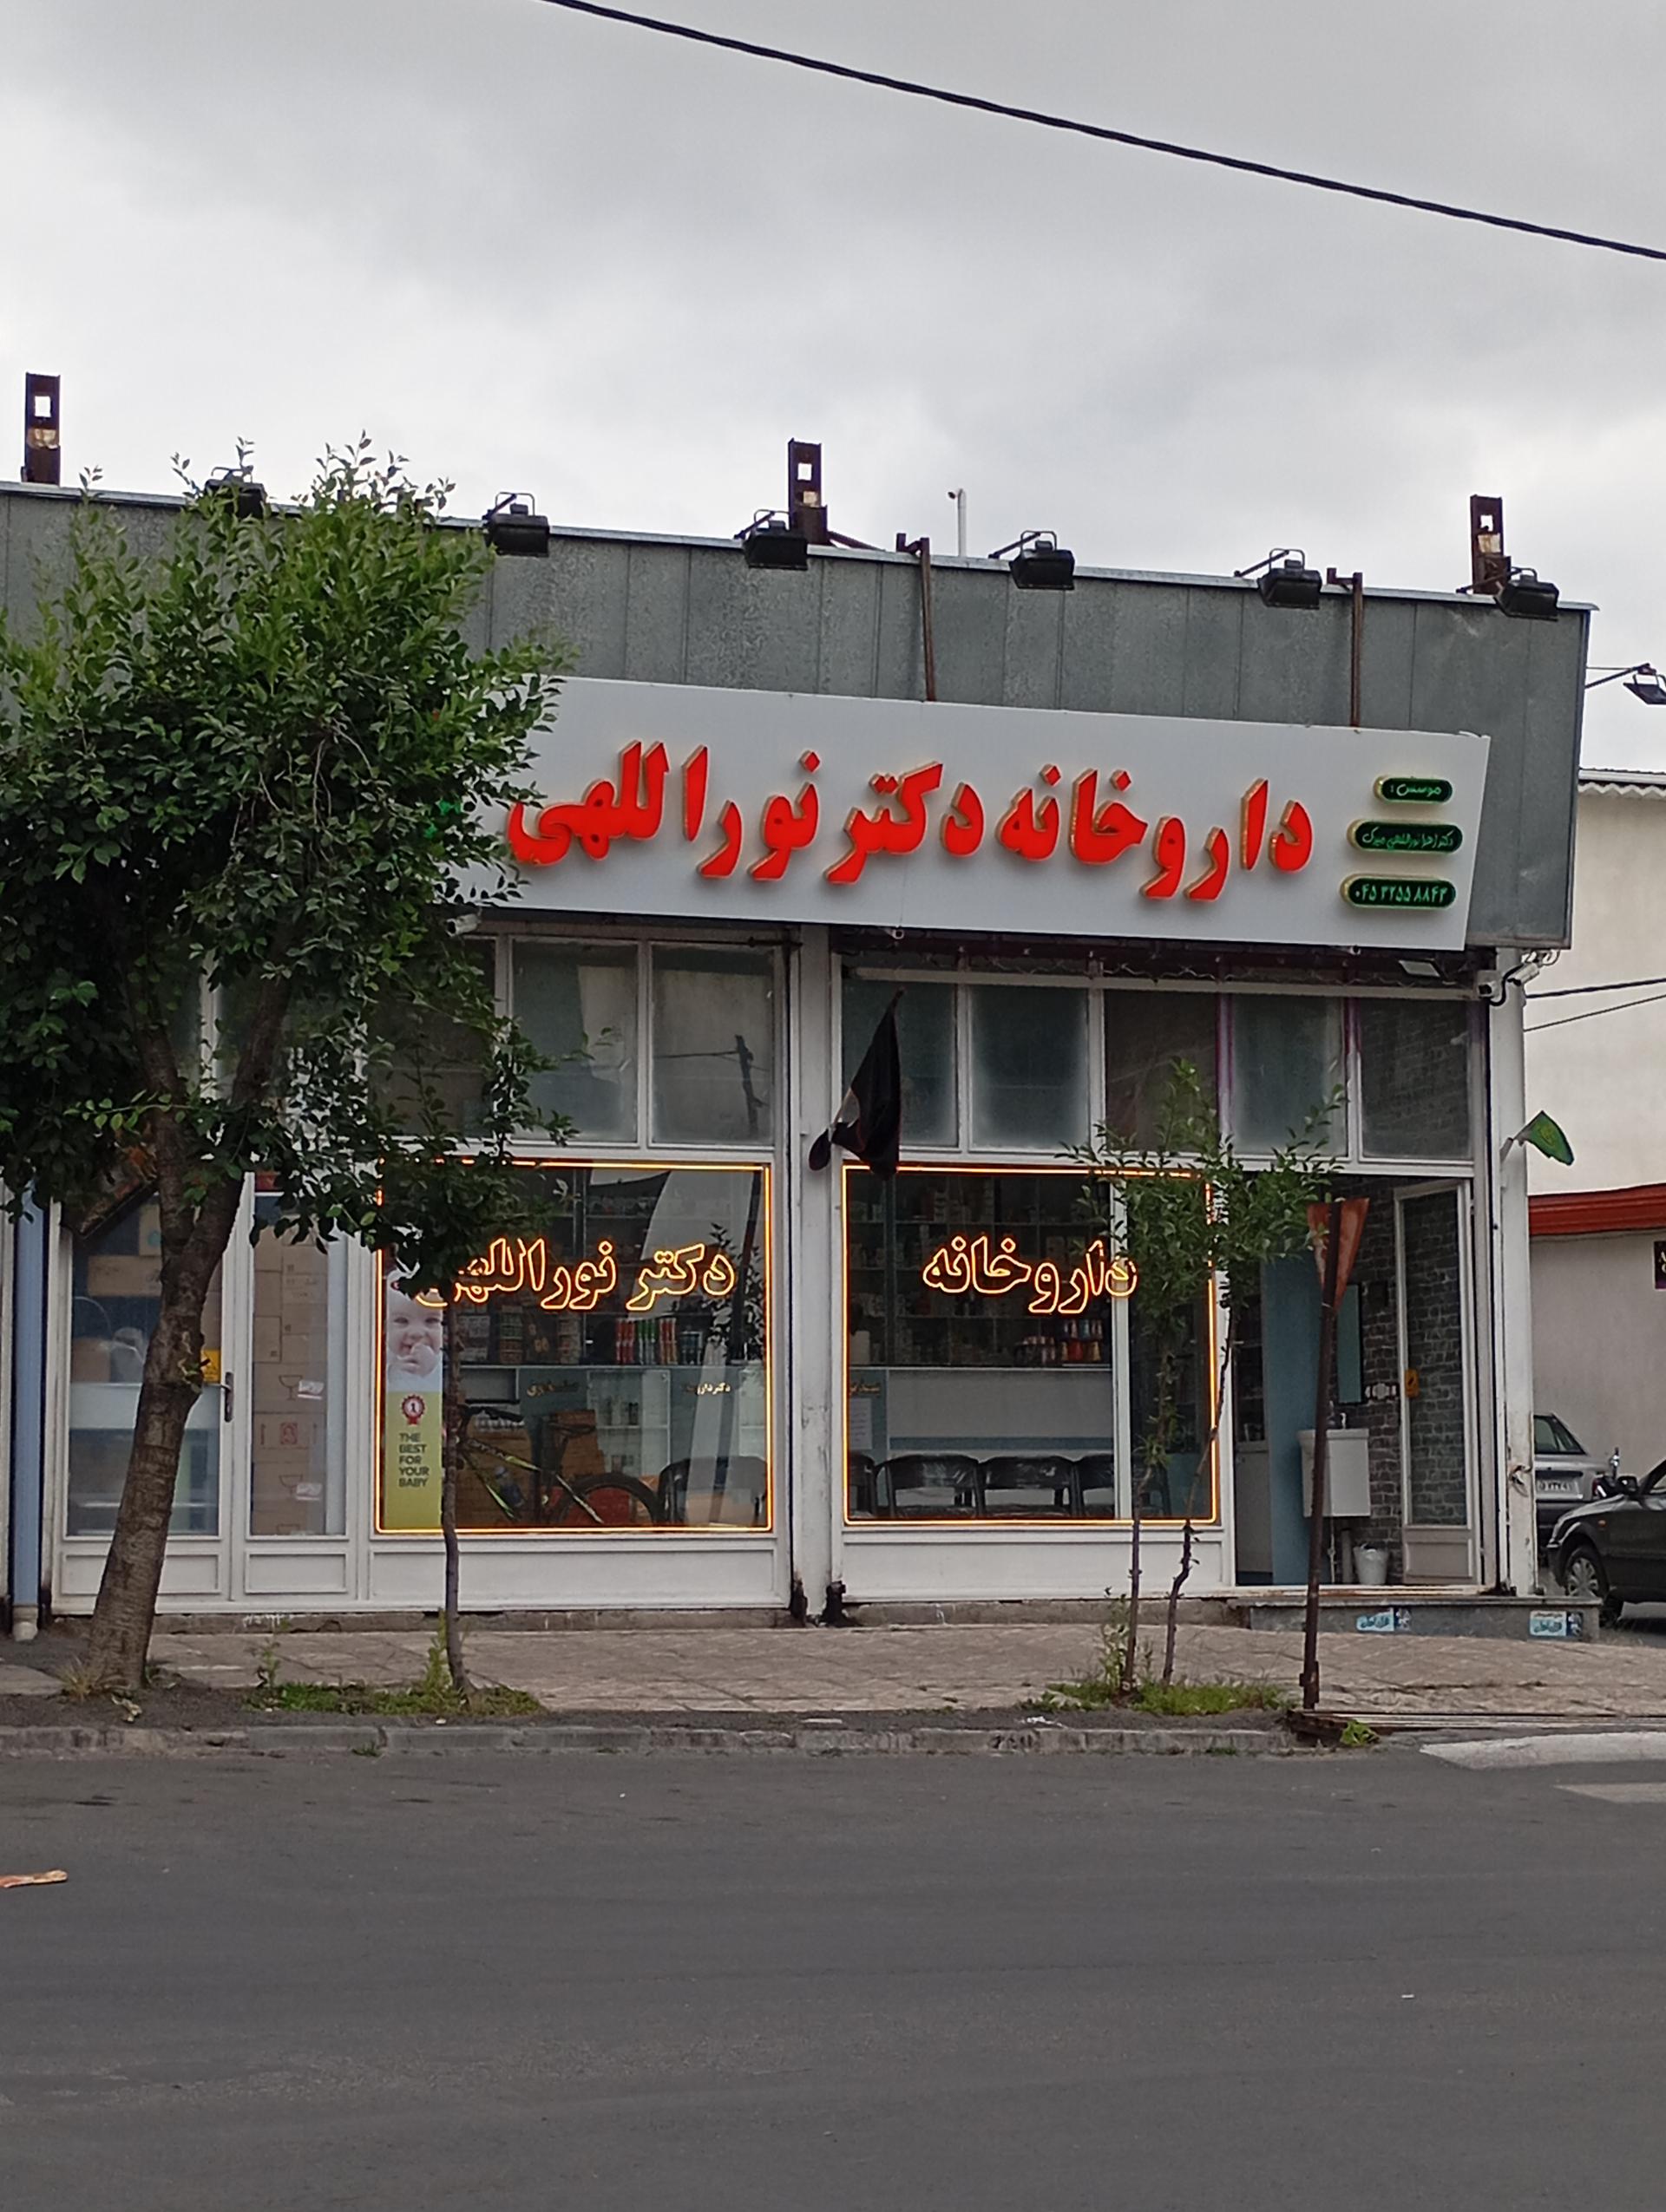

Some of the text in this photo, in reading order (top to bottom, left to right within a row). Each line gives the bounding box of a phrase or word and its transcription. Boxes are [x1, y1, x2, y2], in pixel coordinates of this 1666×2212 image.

[507, 739, 1313, 901] داروخانه دکتر نوراللهی
[626, 1242, 735, 1311] دکتر
[922, 1235, 1138, 1315] داروخانه
[398, 1432, 421, 1443] THE
[398, 1443, 427, 1454] BEST
[398, 1455, 422, 1465] FOR
[398, 1466, 430, 1476] YOUR
[398, 1477, 428, 1488] BABY
